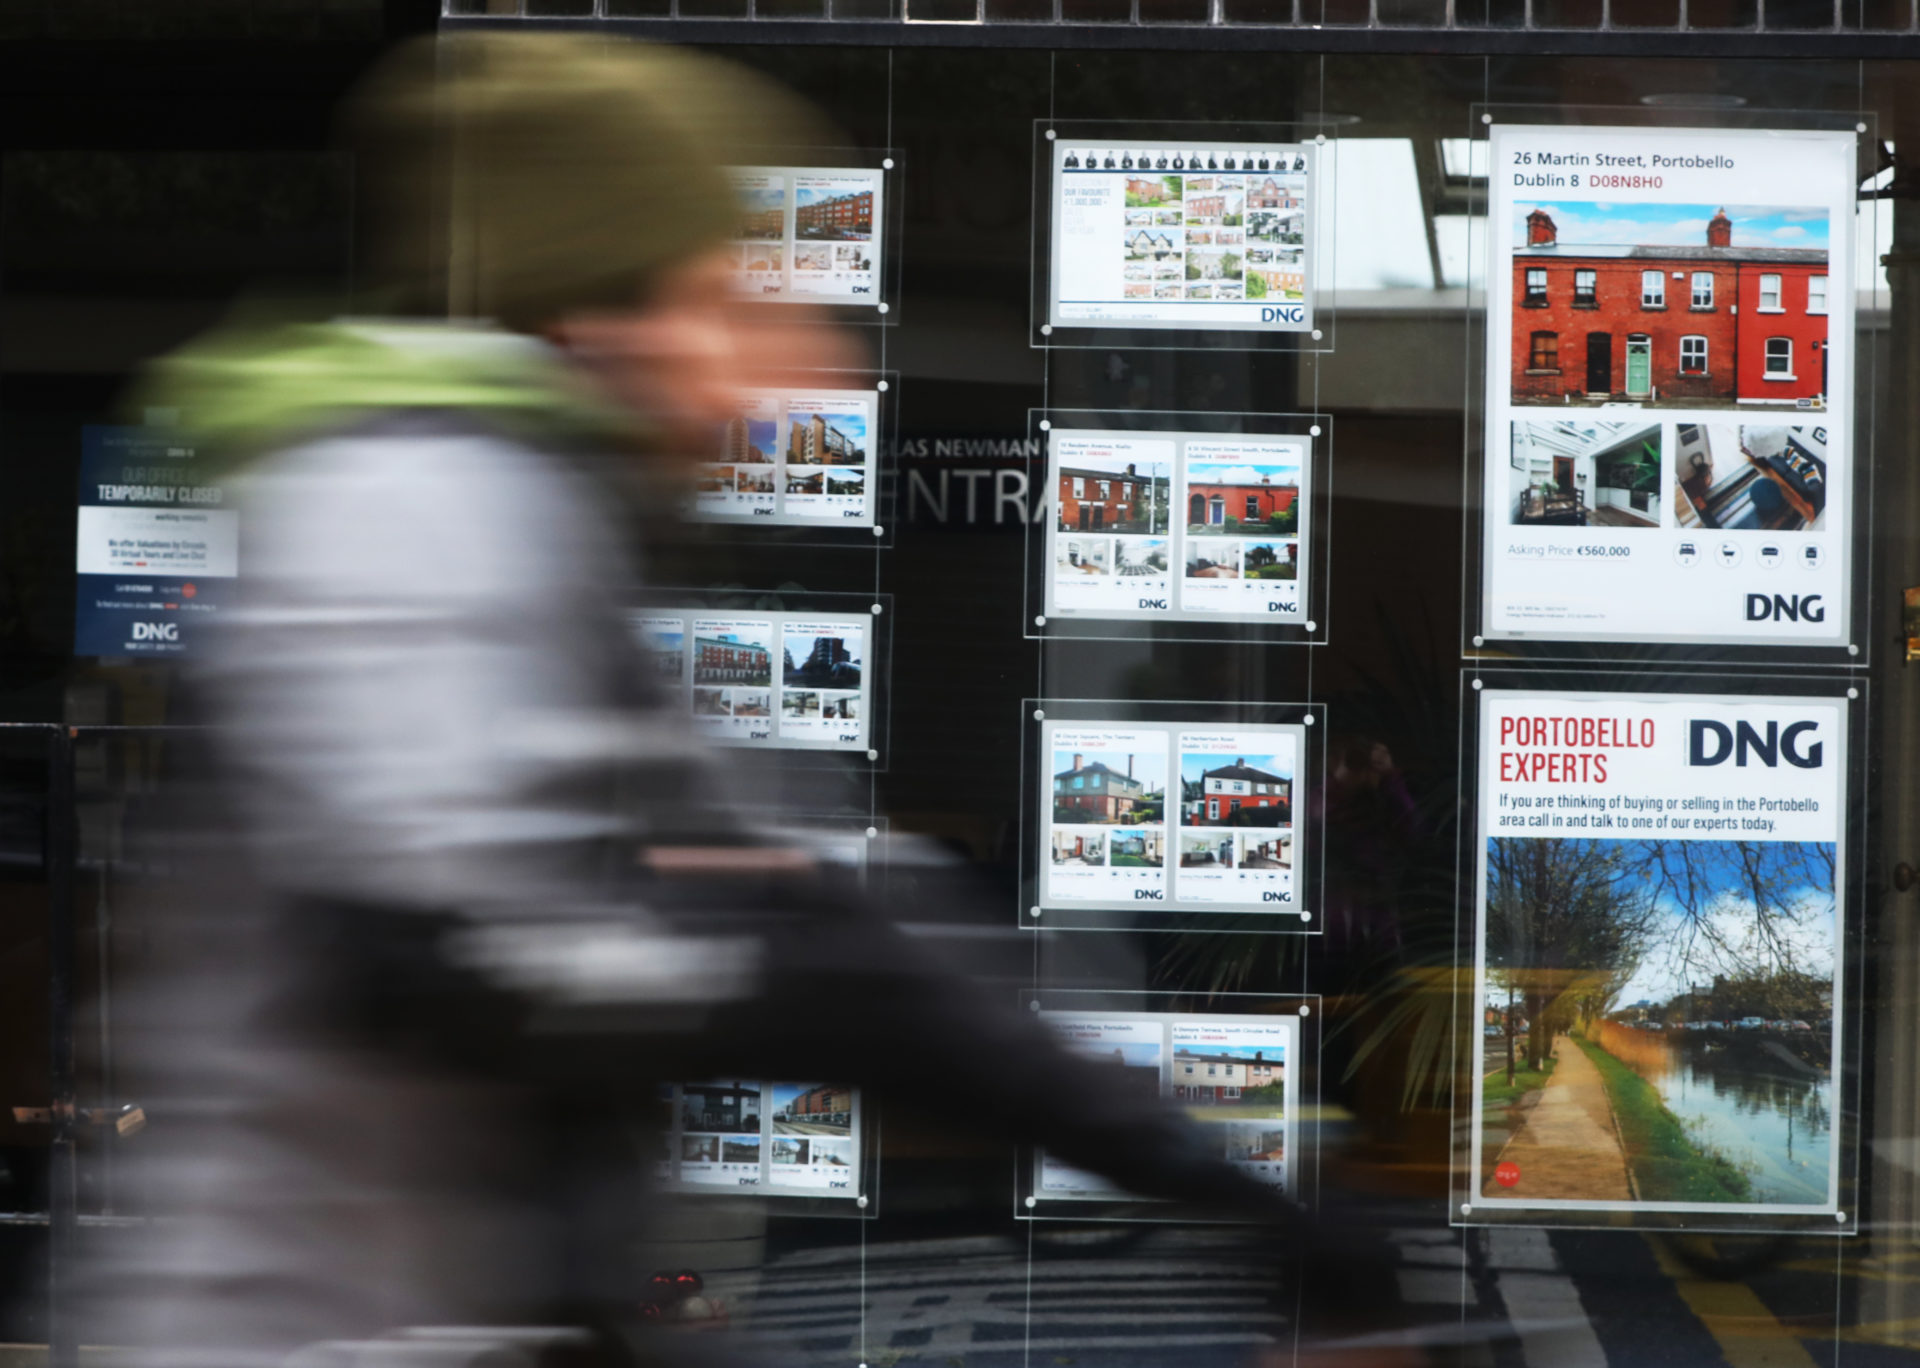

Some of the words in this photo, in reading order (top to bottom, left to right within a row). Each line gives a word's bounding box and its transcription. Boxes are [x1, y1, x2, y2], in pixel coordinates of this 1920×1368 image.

[1514, 152, 1532, 166] 26
[1537, 151, 1590, 167] Martin
[1595, 153, 1647, 169] Street,
[1652, 154, 1735, 169] Portobello
[1513, 173, 1566, 188] Dublin
[1570, 174, 1580, 188] 8
[1589, 174, 1663, 189] D08N8H0
[1261, 307, 1305, 323] DNG
[935, 438, 1040, 457] NEWMAN
[97, 484, 176, 503] TEMPORARILY
[177, 486, 223, 504] CLOSED
[1507, 542, 1545, 559] Asking
[1547, 544, 1574, 557] Price
[1576, 545, 1631, 560] €560,000
[1138, 598, 1168, 610] DNG
[1268, 601, 1297, 613] DNG
[1746, 592, 1825, 623] DNG
[132, 621, 179, 641] DNG
[1499, 716, 1655, 748] PORTOBELLO
[1689, 719, 1823, 769] DNG
[1499, 752, 1608, 783] EXPERTS
[1499, 794, 1508, 809] If
[1510, 797, 1532, 812] you
[1535, 797, 1554, 809] are
[1556, 794, 1607, 812] thinking
[1609, 795, 1622, 810] of
[1624, 795, 1664, 813] buying
[1666, 799, 1679, 811] or
[1681, 796, 1721, 814] selling
[1722, 797, 1734, 812] in
[1736, 797, 1756, 812] the
[1758, 797, 1819, 813] Portobello
[1499, 815, 1526, 828] area
[1527, 813, 1550, 828] call
[1551, 813, 1563, 828] in
[1565, 814, 1588, 829] and
[1590, 814, 1613, 829] talk
[1615, 815, 1629, 829] to
[1631, 817, 1650, 830] one
[1653, 815, 1668, 830] of
[1669, 817, 1691, 830] our
[1692, 816, 1738, 833] experts
[1740, 815, 1778, 833] today.
[1134, 889, 1164, 900] DNG
[1262, 891, 1292, 902] DNG
